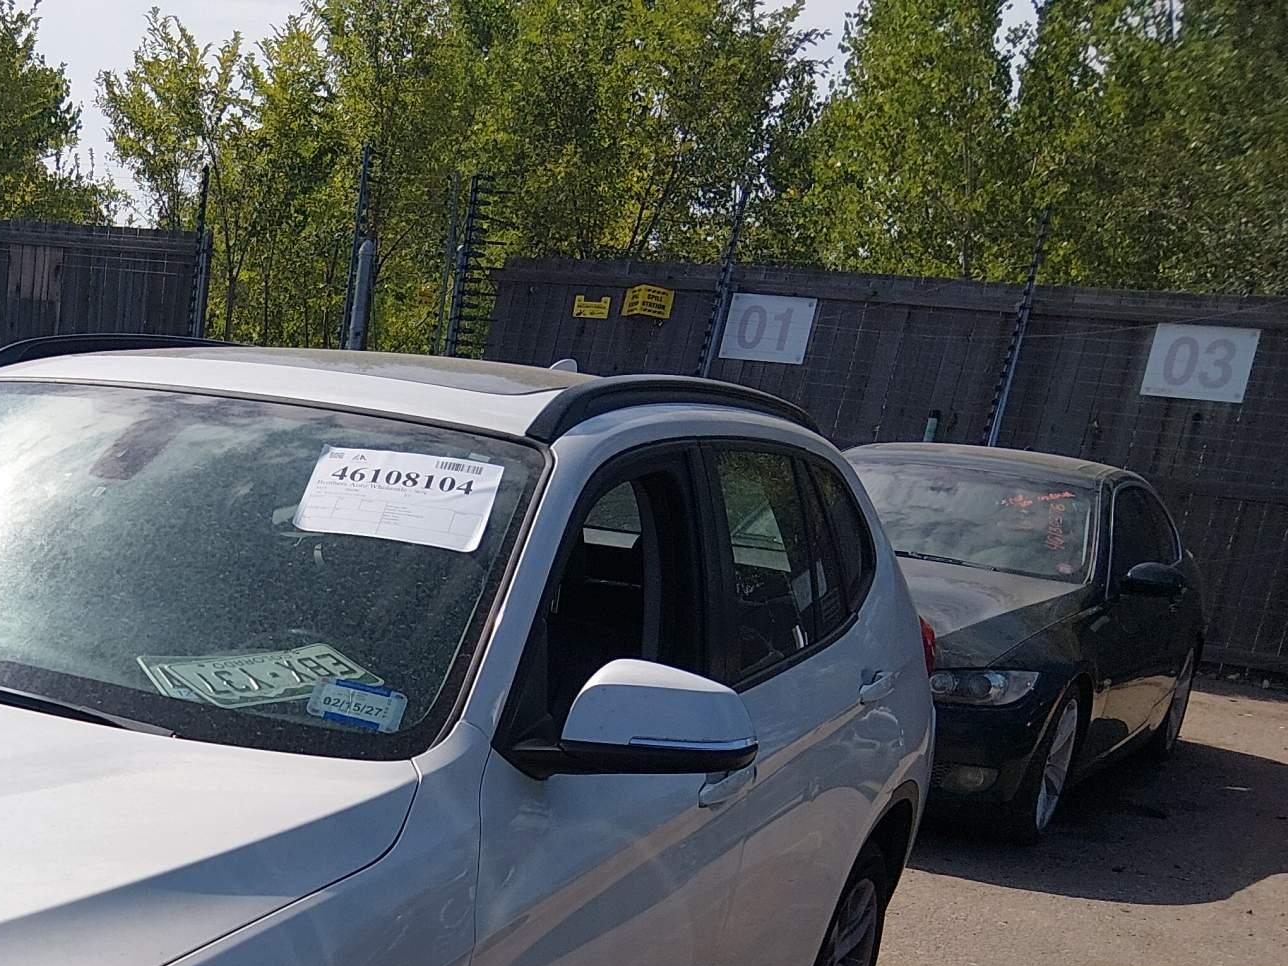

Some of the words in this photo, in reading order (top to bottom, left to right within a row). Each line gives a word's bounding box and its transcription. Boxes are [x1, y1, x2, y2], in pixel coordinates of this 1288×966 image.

[737, 305, 794, 351] 01
[1163, 336, 1236, 389] 03
[331, 465, 474, 496] 46108104
[322, 696, 383, 717] 02/15/27
